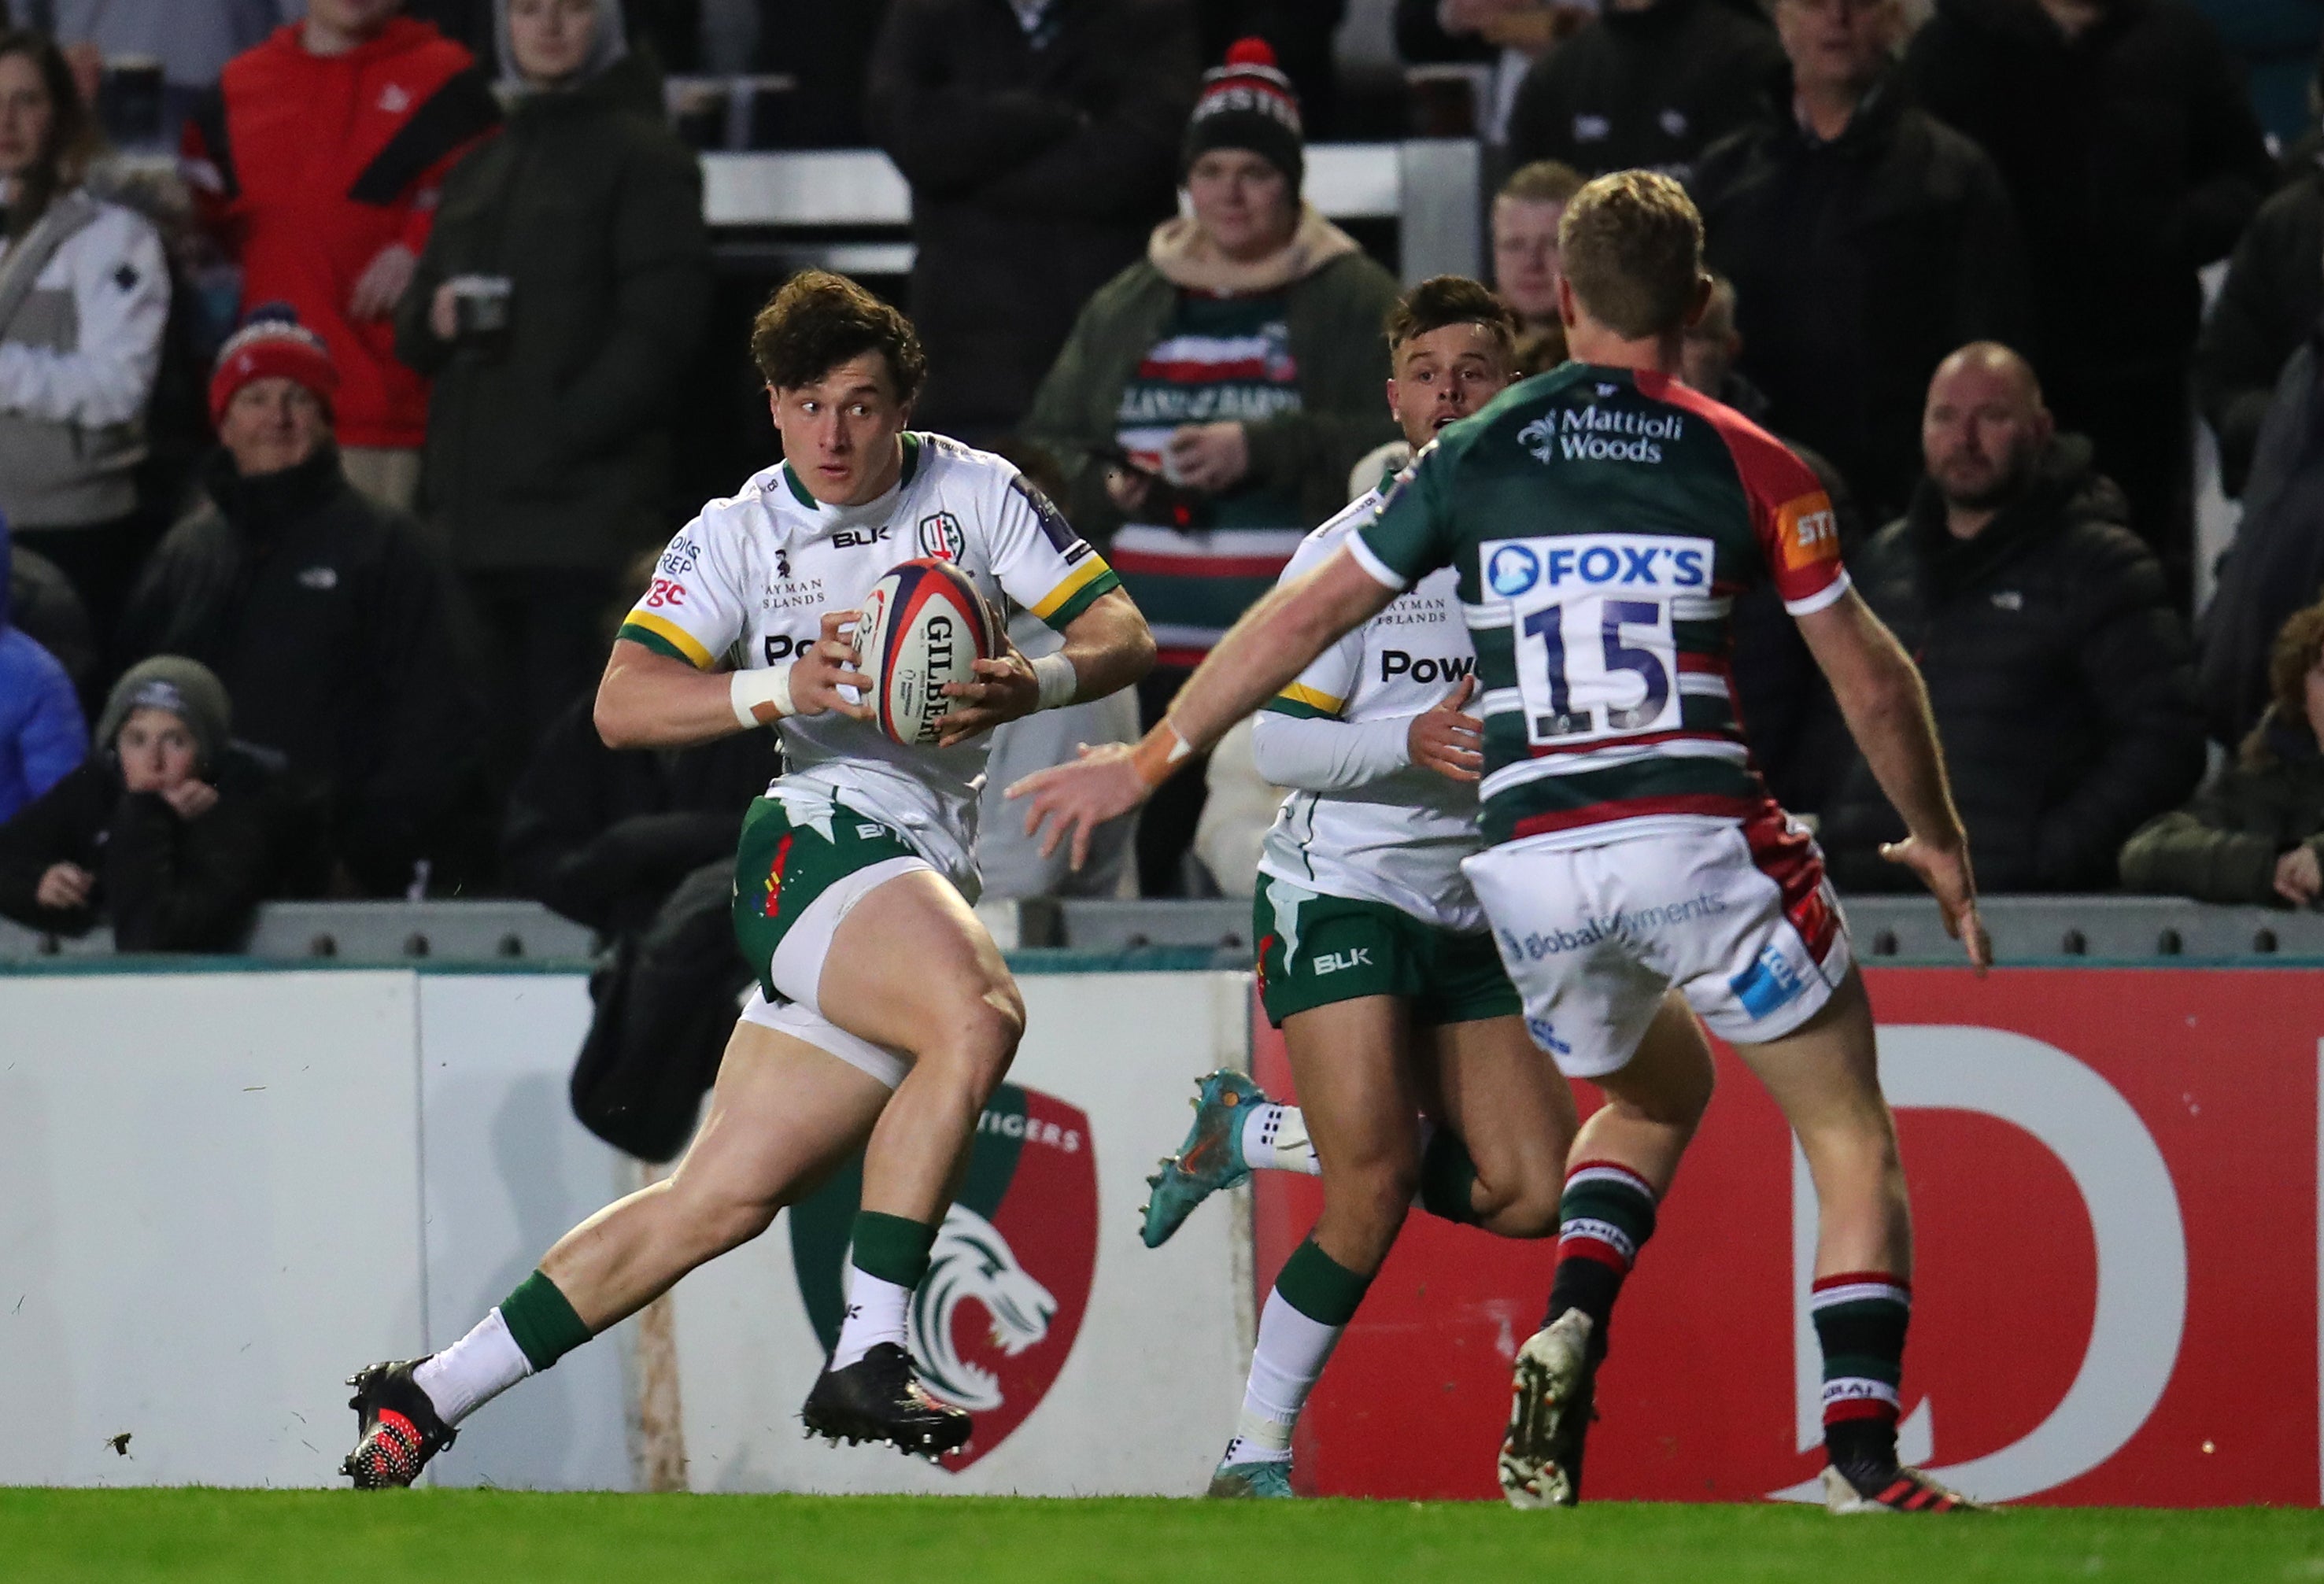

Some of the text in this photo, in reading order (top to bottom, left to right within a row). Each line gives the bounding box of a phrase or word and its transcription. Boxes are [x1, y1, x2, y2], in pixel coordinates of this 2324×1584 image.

[1561, 404, 1683, 441] Mattioli
[1560, 434, 1663, 465] Woods
[832, 526, 892, 549] BLK
[660, 552, 693, 575] REP
[1547, 546, 1704, 587] FOX'S
[645, 578, 687, 608] gc
[760, 578, 823, 596] AYMAN
[762, 593, 826, 610] SLANDS
[1388, 598, 1446, 612] AYMAN
[764, 634, 817, 667] Po
[914, 615, 953, 744] GILBER
[1381, 649, 1481, 684] Pow
[1524, 600, 1669, 738] 15
[1313, 947, 1373, 976] BLK
[977, 1109, 1079, 1154] TIGERS
